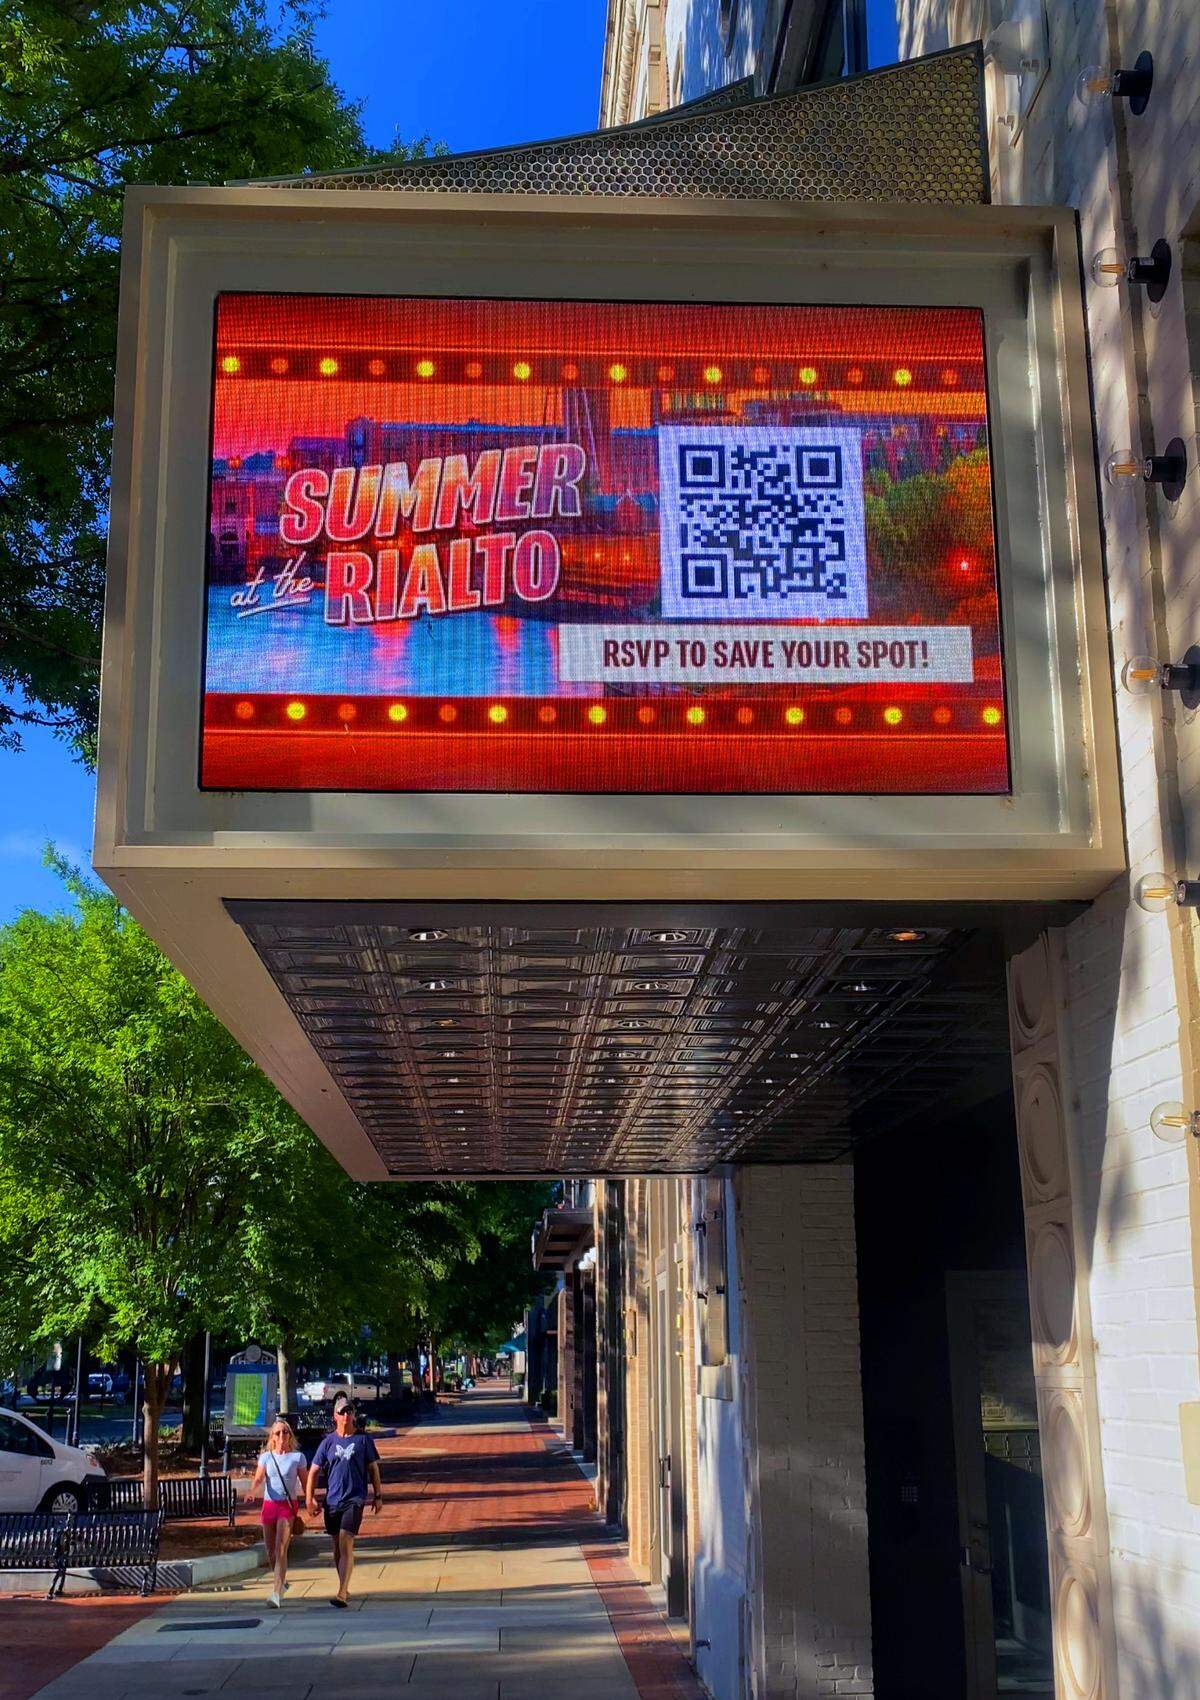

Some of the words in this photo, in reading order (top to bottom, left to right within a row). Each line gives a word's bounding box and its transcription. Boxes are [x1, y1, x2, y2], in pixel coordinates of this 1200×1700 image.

[279, 443, 586, 545] SUMMER
[230, 566, 265, 606] at
[273, 551, 314, 598] the
[324, 529, 561, 625] RIALTO
[604, 639, 670, 667] RSVP
[676, 639, 706, 667] TO
[714, 640, 774, 668] SAVE
[780, 640, 851, 668] YOUR
[857, 640, 930, 669] SPOT!
